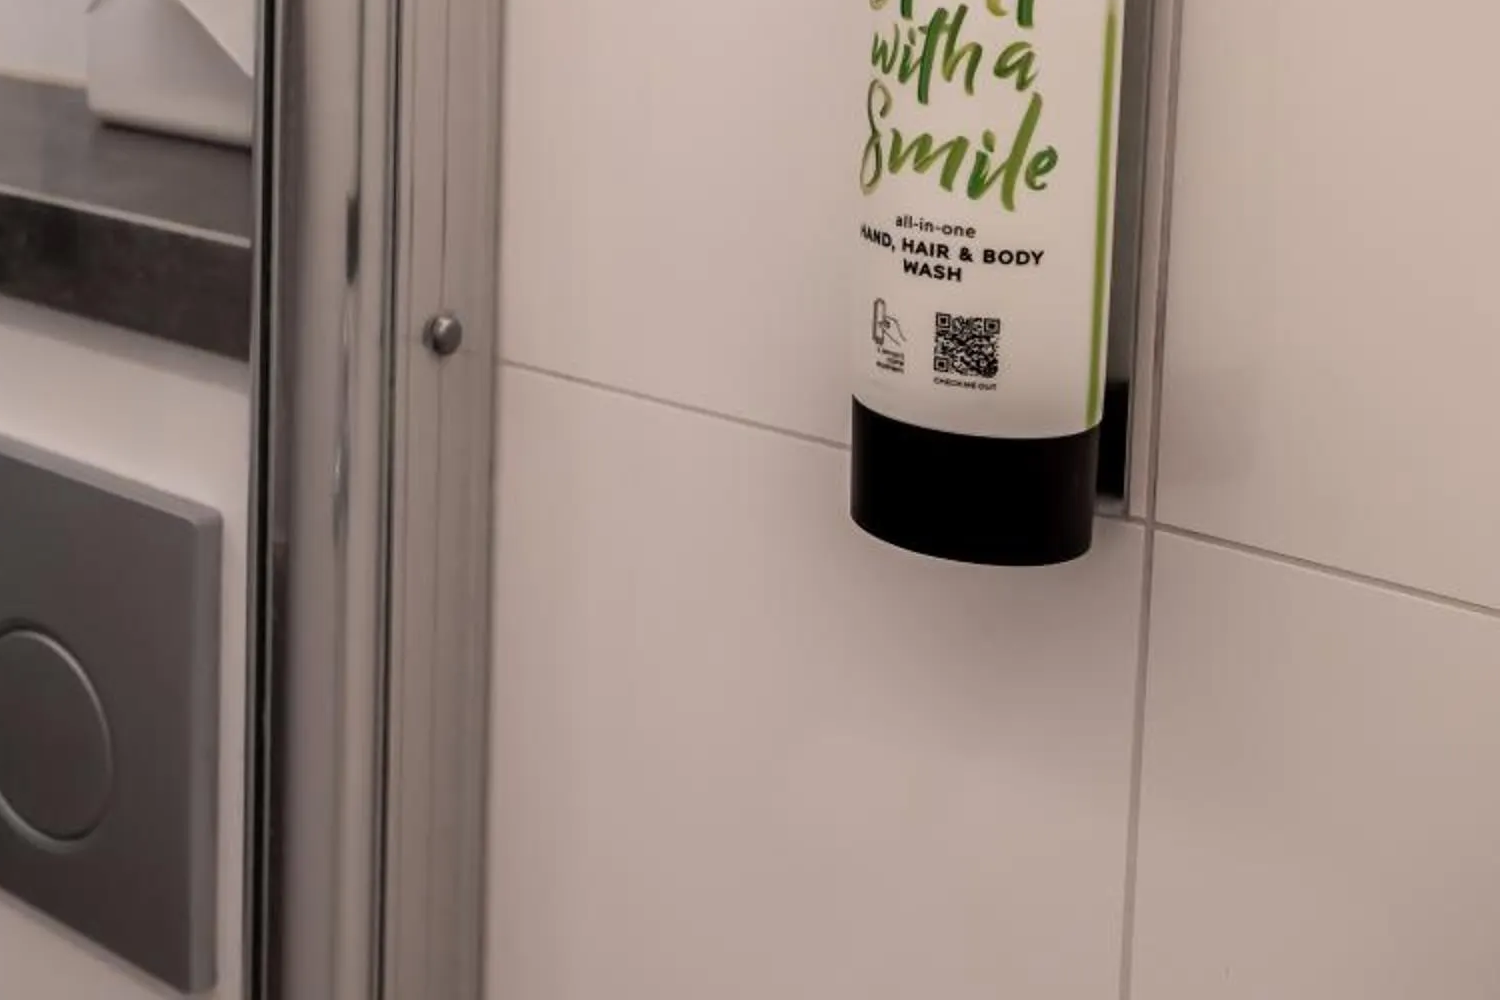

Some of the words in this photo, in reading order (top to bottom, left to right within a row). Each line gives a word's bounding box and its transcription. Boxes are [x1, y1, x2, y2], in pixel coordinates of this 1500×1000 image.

[871, 3, 982, 105] with
[993, 41, 1038, 91] a
[860, 79, 1058, 212] Smile
[896, 215, 976, 238] all-in-one
[902, 237, 949, 259] HAIR
[959, 247, 973, 262] &
[983, 249, 1044, 265] BODY
[903, 258, 961, 282] WASH
